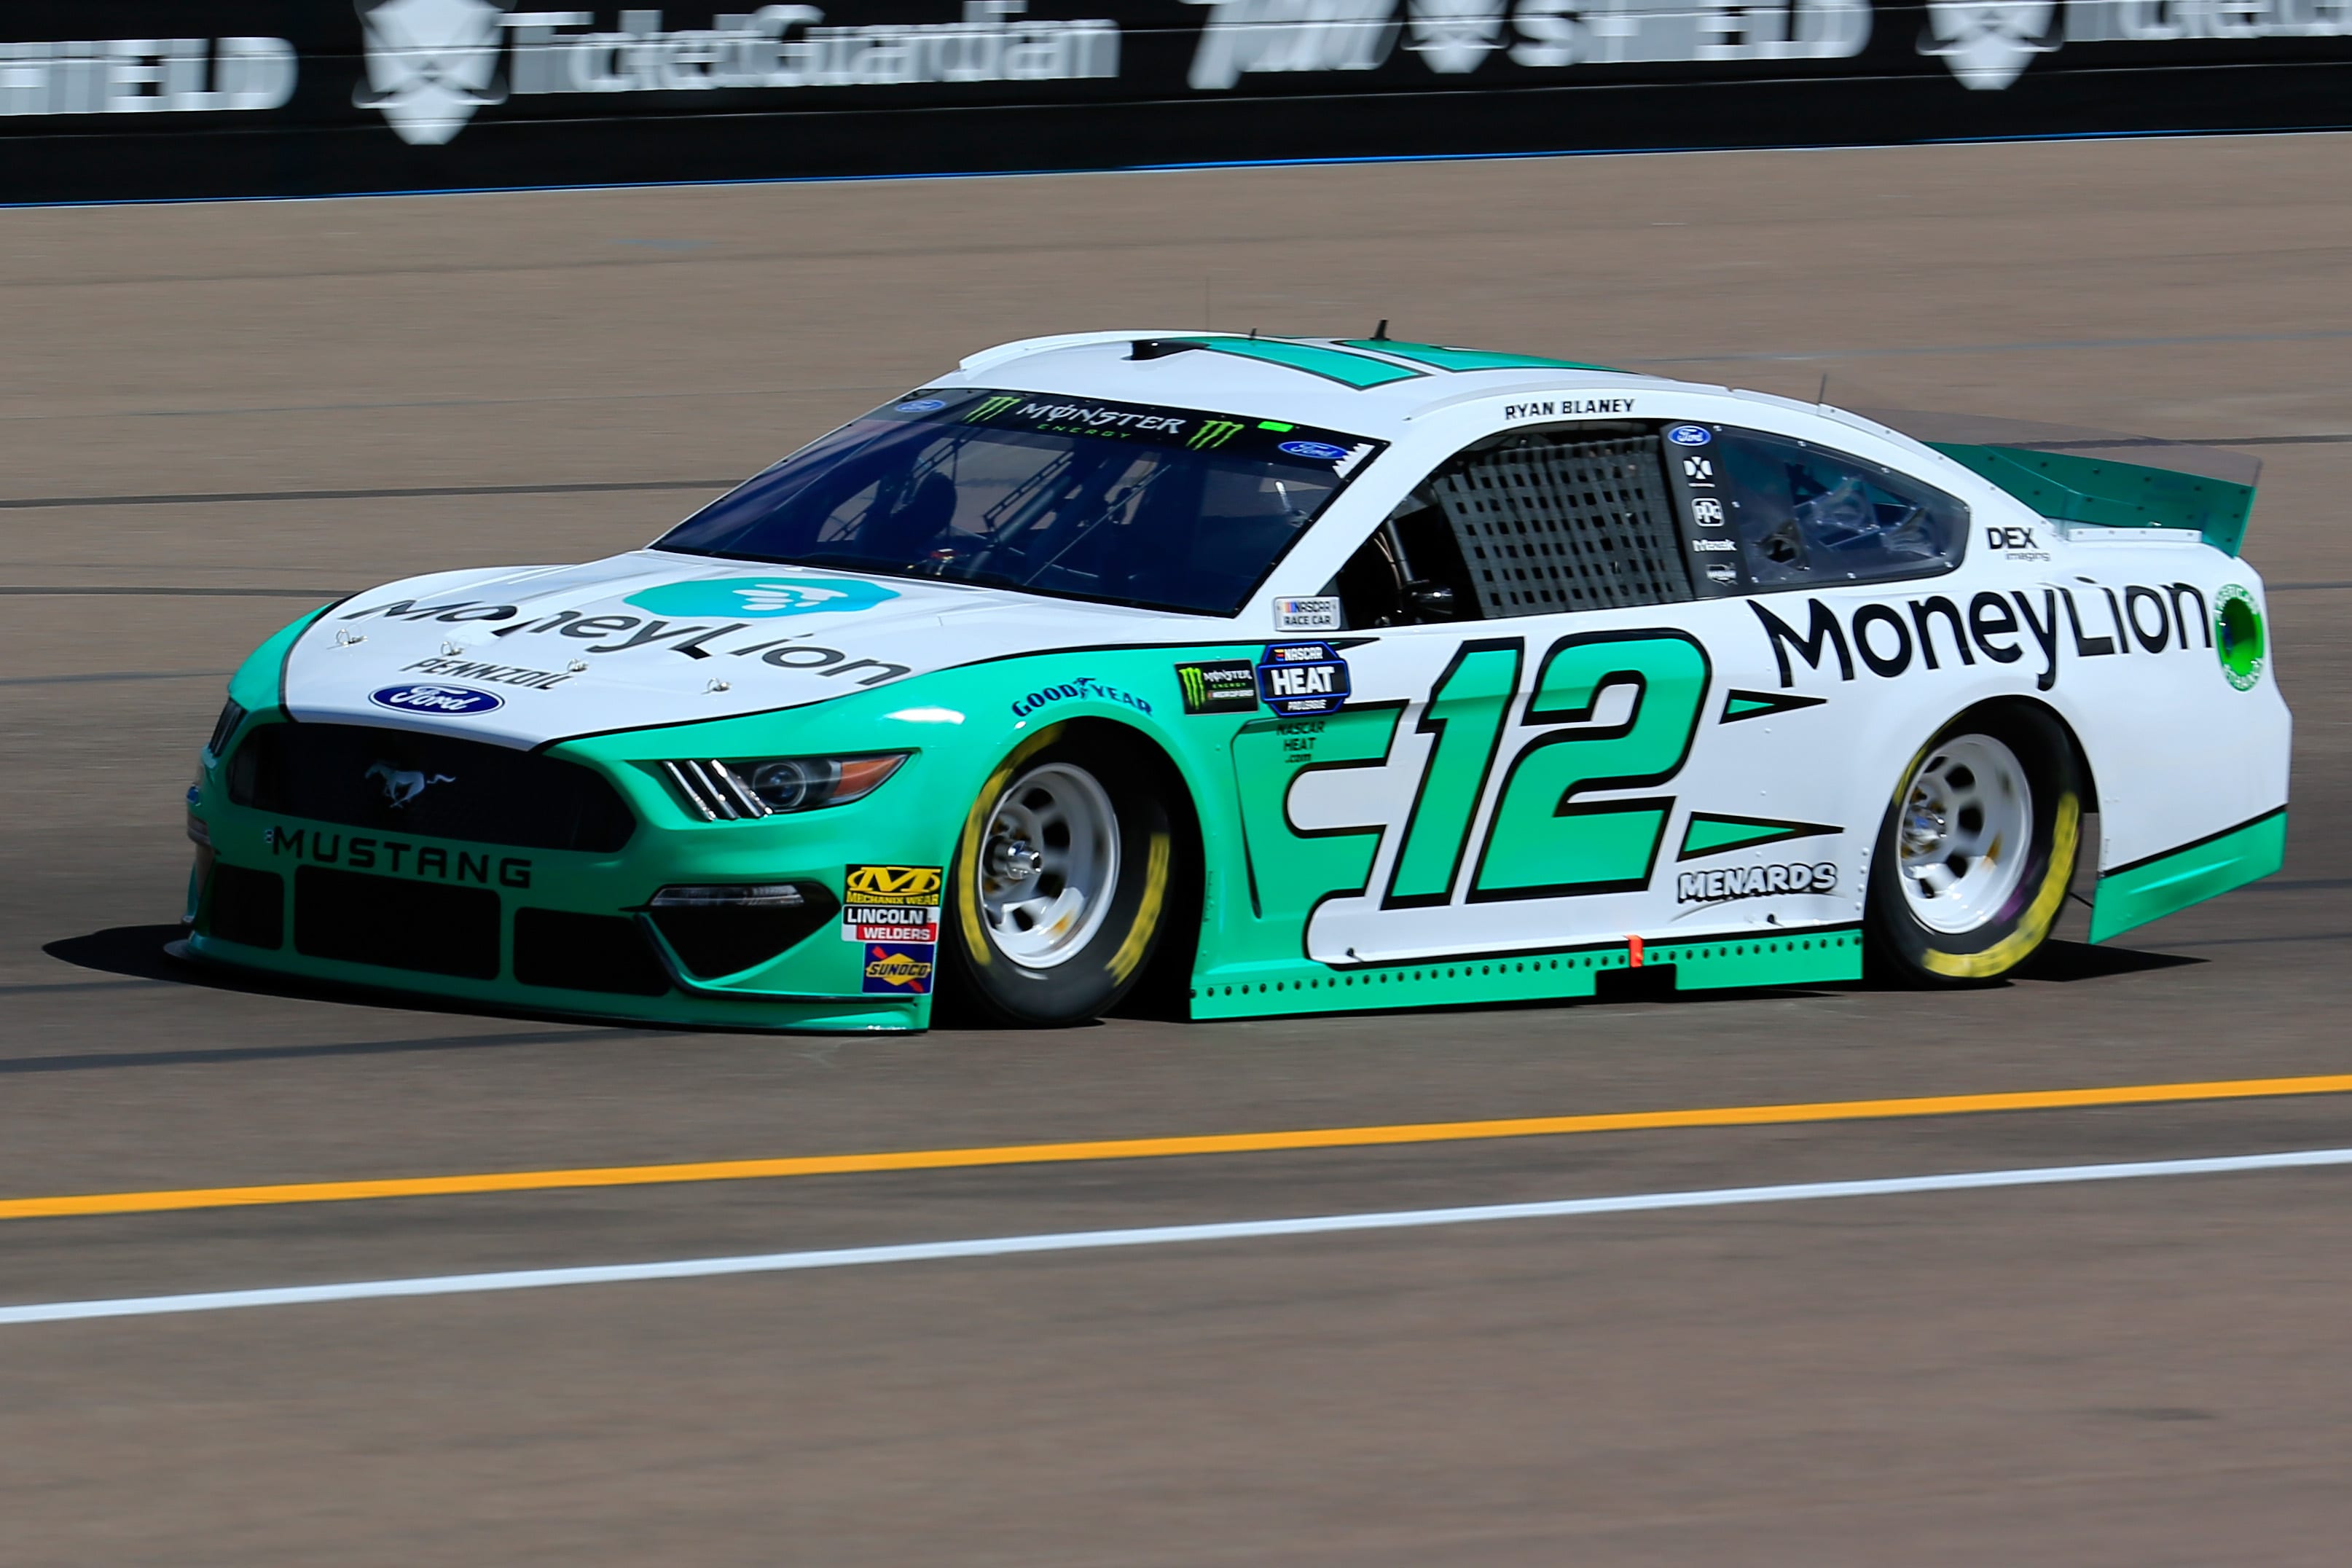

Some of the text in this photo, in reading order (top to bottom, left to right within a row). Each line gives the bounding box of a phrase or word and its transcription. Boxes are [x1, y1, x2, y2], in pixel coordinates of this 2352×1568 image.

[1505, 399, 1635, 420] RYAN BLANEY
[1038, 424, 1131, 438] ENERGY
[1290, 442, 1339, 457] Ford
[1986, 526, 2039, 549] DEX
[1291, 601, 1331, 613] NASCAR
[1284, 615, 1332, 625] RACE CAR
[1747, 576, 2213, 691] MoneyLion
[338, 600, 912, 686] MoneyLion
[1285, 647, 1323, 661] NASCAR
[399, 658, 574, 690] PENNZOIL
[1271, 666, 1335, 695] HEAT
[388, 686, 481, 711] Ford
[1277, 721, 1325, 736] NASCAR
[1283, 737, 1316, 751] HEAT
[1380, 627, 1712, 911] 12
[273, 826, 532, 889] MUSTANG
[1677, 863, 1838, 903] MENARDS
[846, 890, 939, 905] MECHANIX WEAR
[847, 908, 924, 925] LINCOLN
[863, 926, 931, 941] WELDERS
[868, 963, 929, 977] SUNOCO
